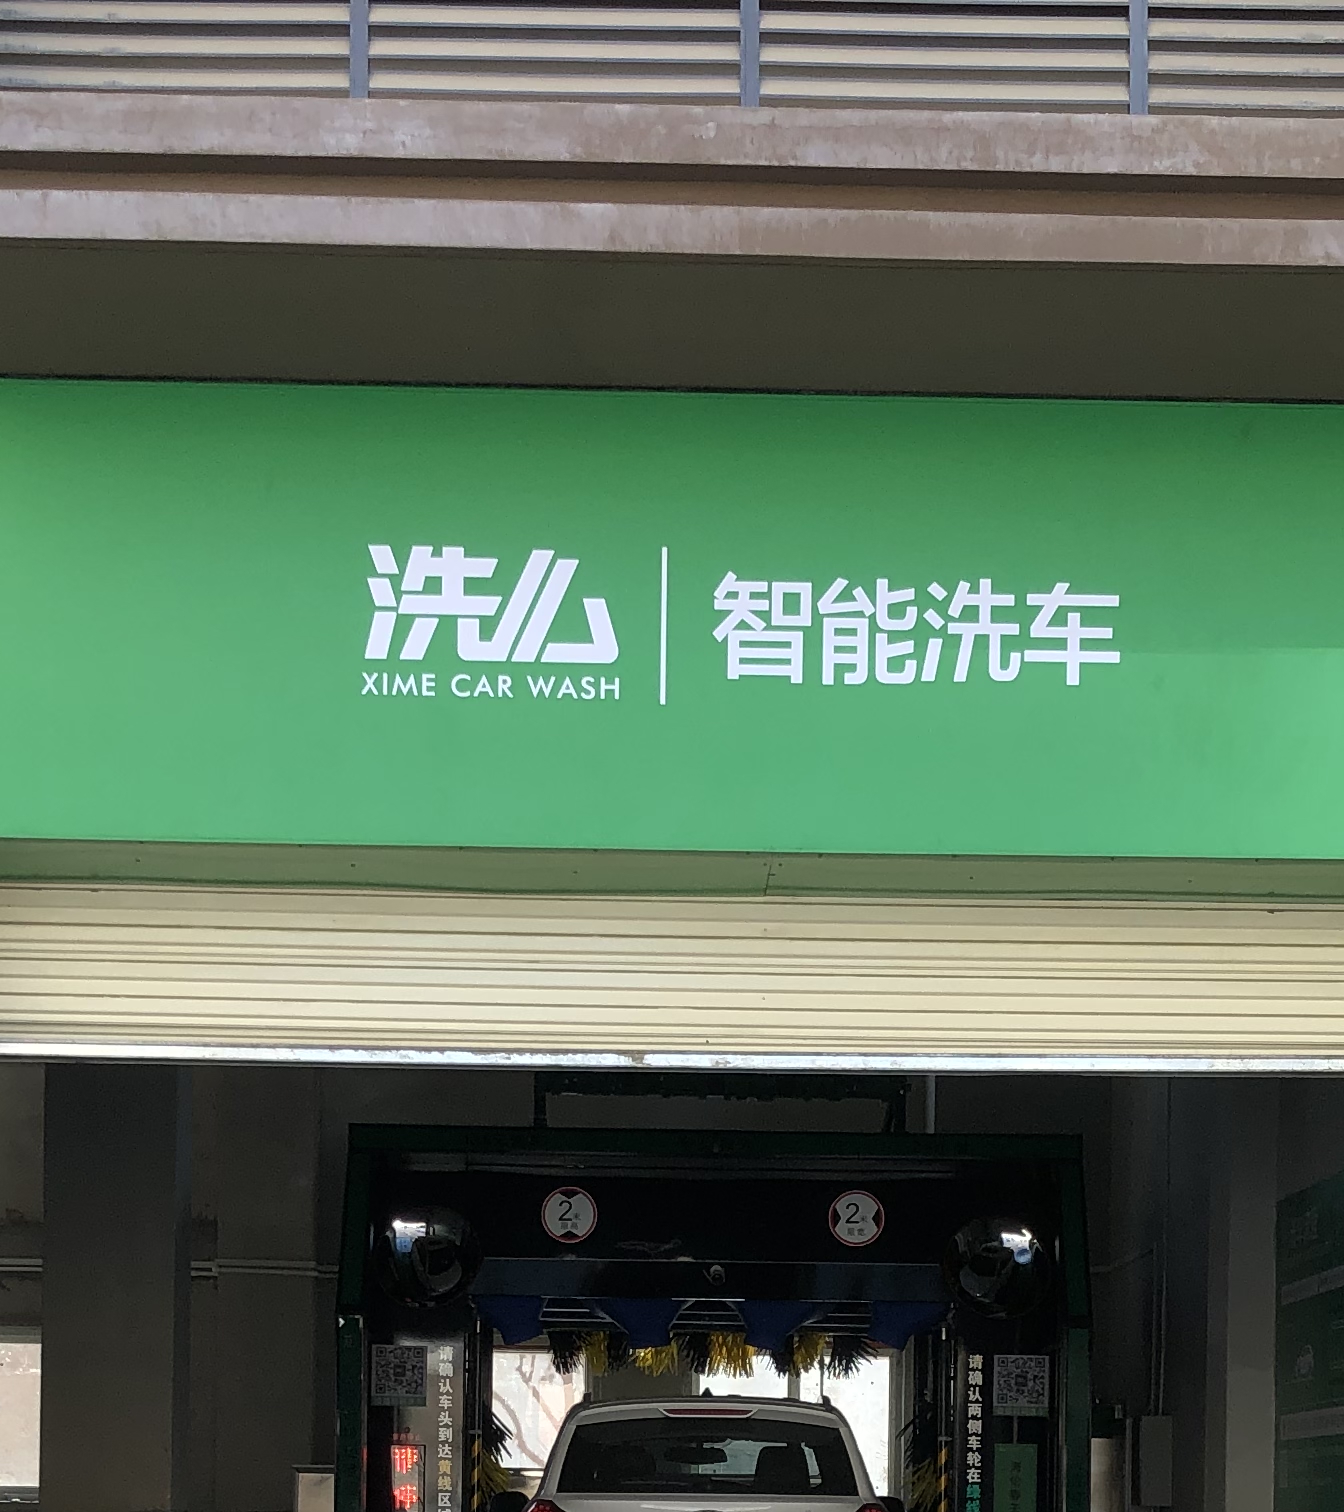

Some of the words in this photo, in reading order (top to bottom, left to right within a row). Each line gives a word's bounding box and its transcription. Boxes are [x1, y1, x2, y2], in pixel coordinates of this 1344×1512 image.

[712, 571, 1122, 687] 智能洗车
[361, 673, 436, 698] XIME
[450, 674, 514, 699] CAR
[527, 675, 621, 701] WASH
